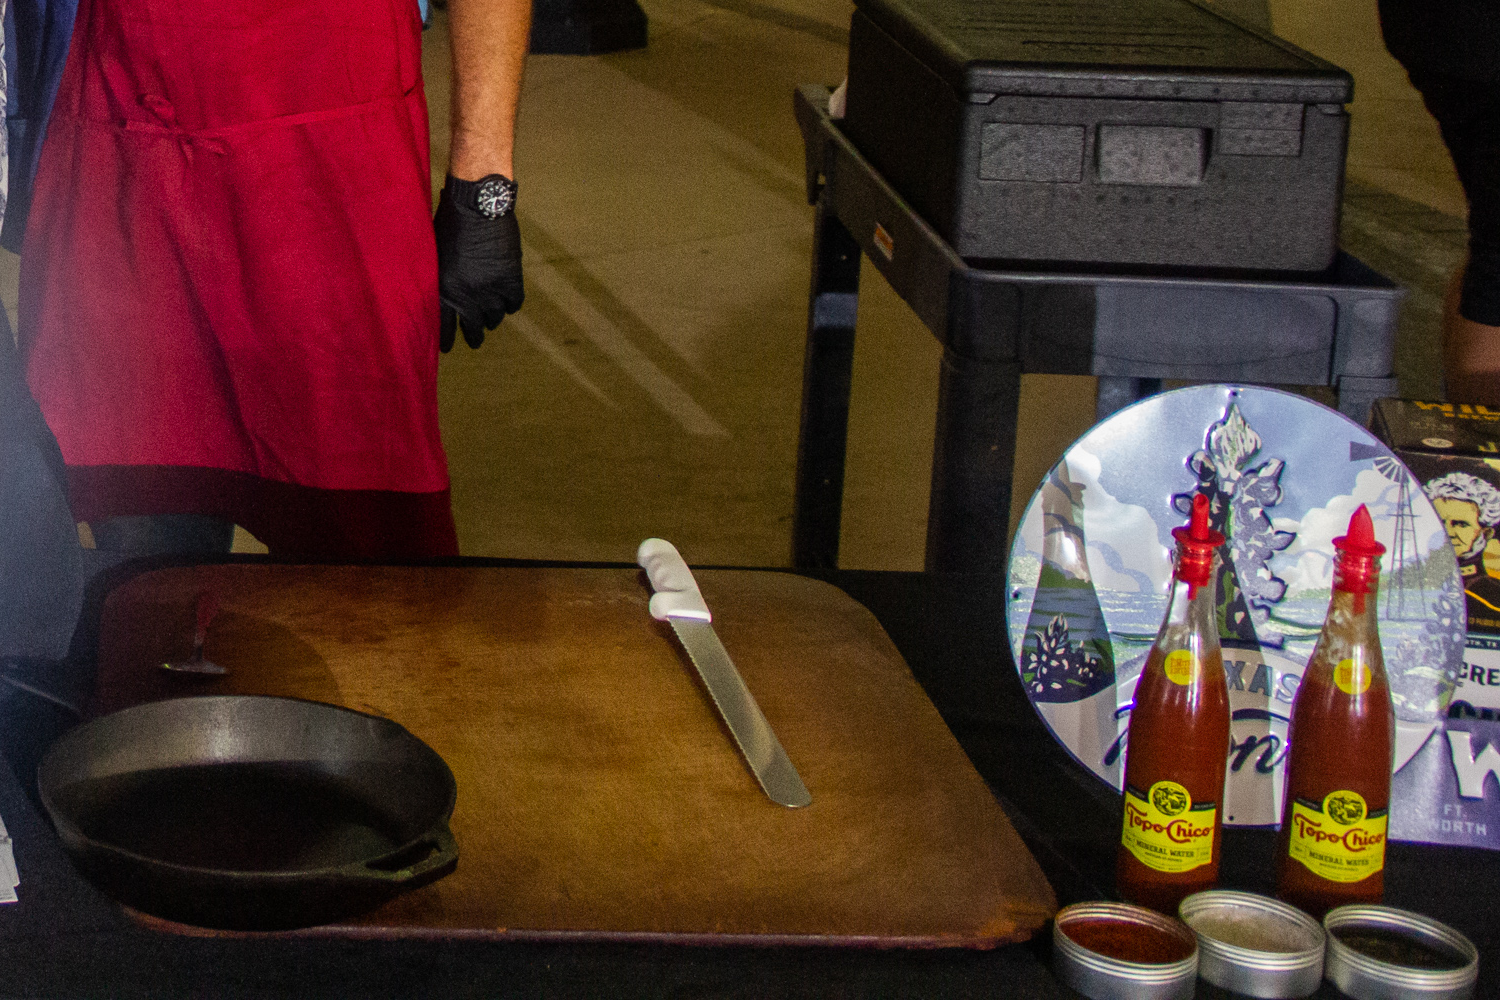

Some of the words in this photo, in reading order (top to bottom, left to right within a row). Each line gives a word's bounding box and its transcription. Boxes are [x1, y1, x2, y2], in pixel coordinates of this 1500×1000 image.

[1225, 659, 1301, 705] XAS
[1126, 802, 1165, 833] Topo
[1165, 819, 1214, 844] Chico
[1444, 804, 1468, 819] FT.
[1294, 812, 1340, 843] Topo
[1342, 828, 1385, 852] Chico
[1136, 840, 1167, 855] MINERAL
[1169, 849, 1194, 857] WATER
[1309, 850, 1343, 865] MINERAL
[1345, 858, 1369, 866] WATER
